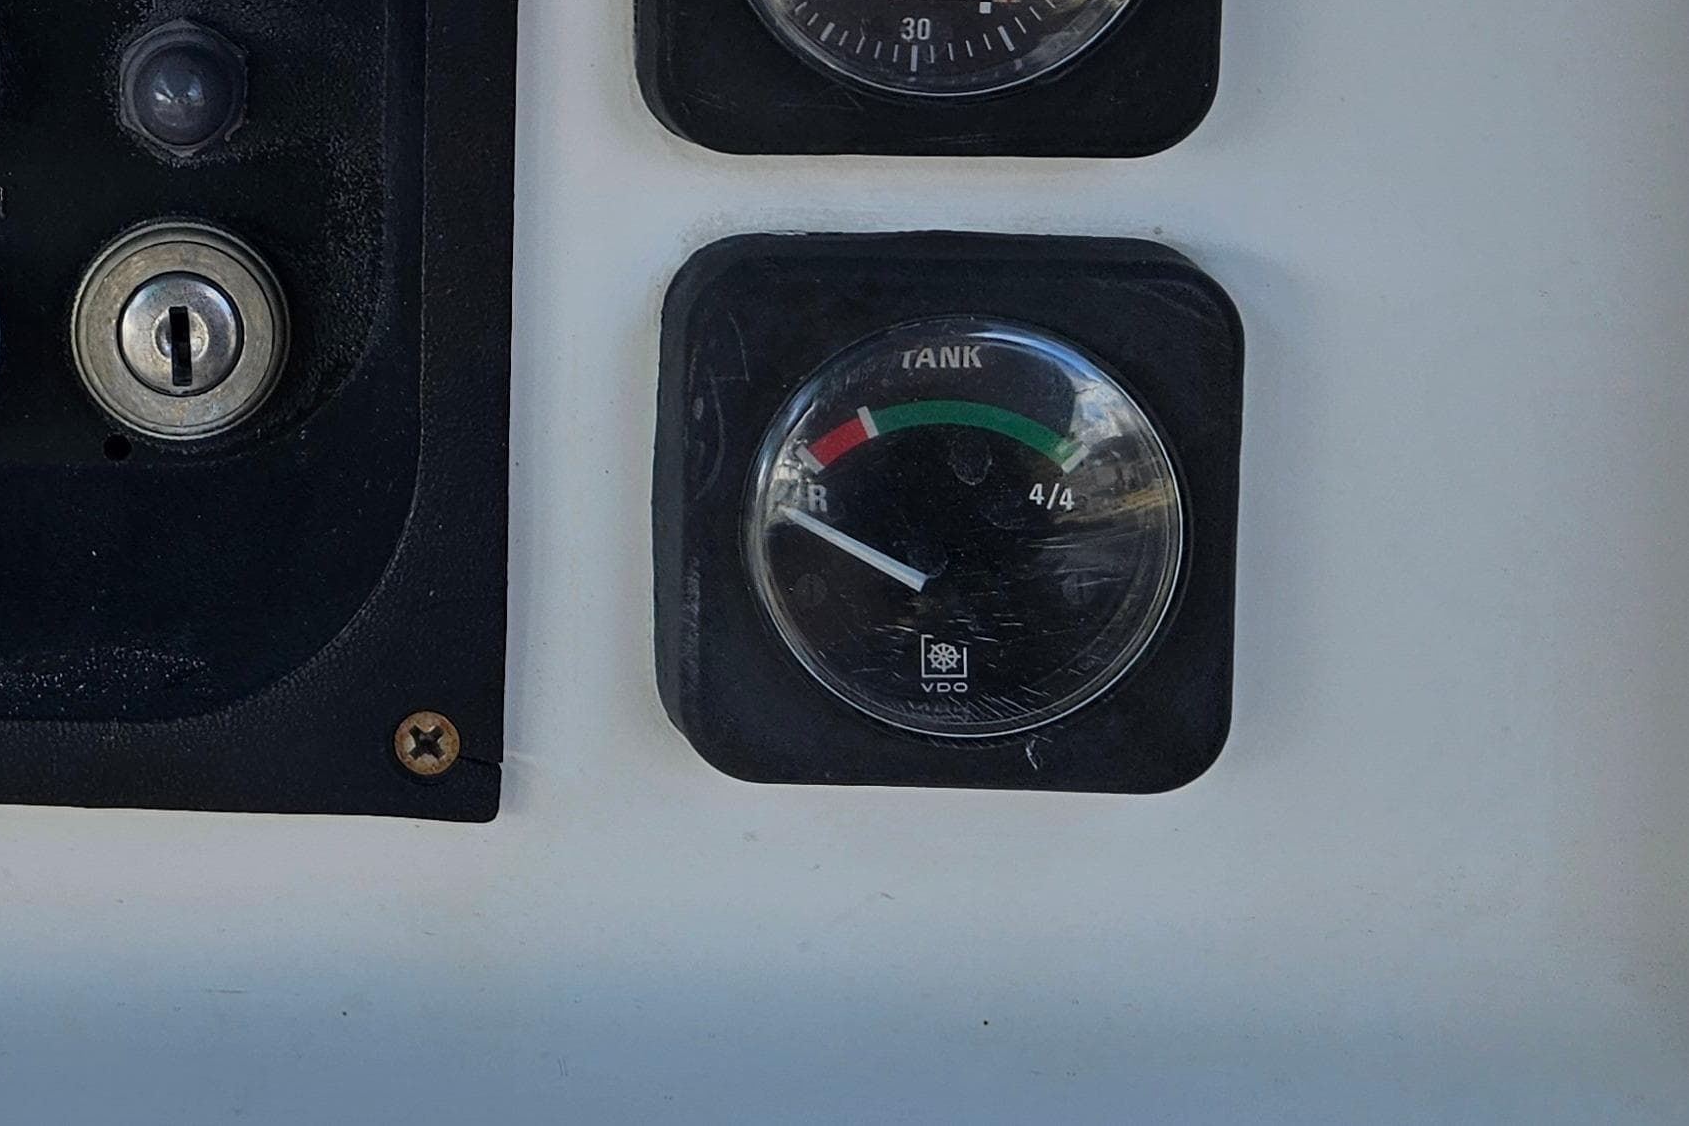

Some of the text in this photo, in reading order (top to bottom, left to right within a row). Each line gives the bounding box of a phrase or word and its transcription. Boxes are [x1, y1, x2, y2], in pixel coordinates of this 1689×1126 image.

[900, 17, 932, 41] 30
[900, 345, 984, 370] TANK
[807, 483, 828, 513] R
[1027, 482, 1075, 512] 4/4
[920, 682, 969, 693] VDO
